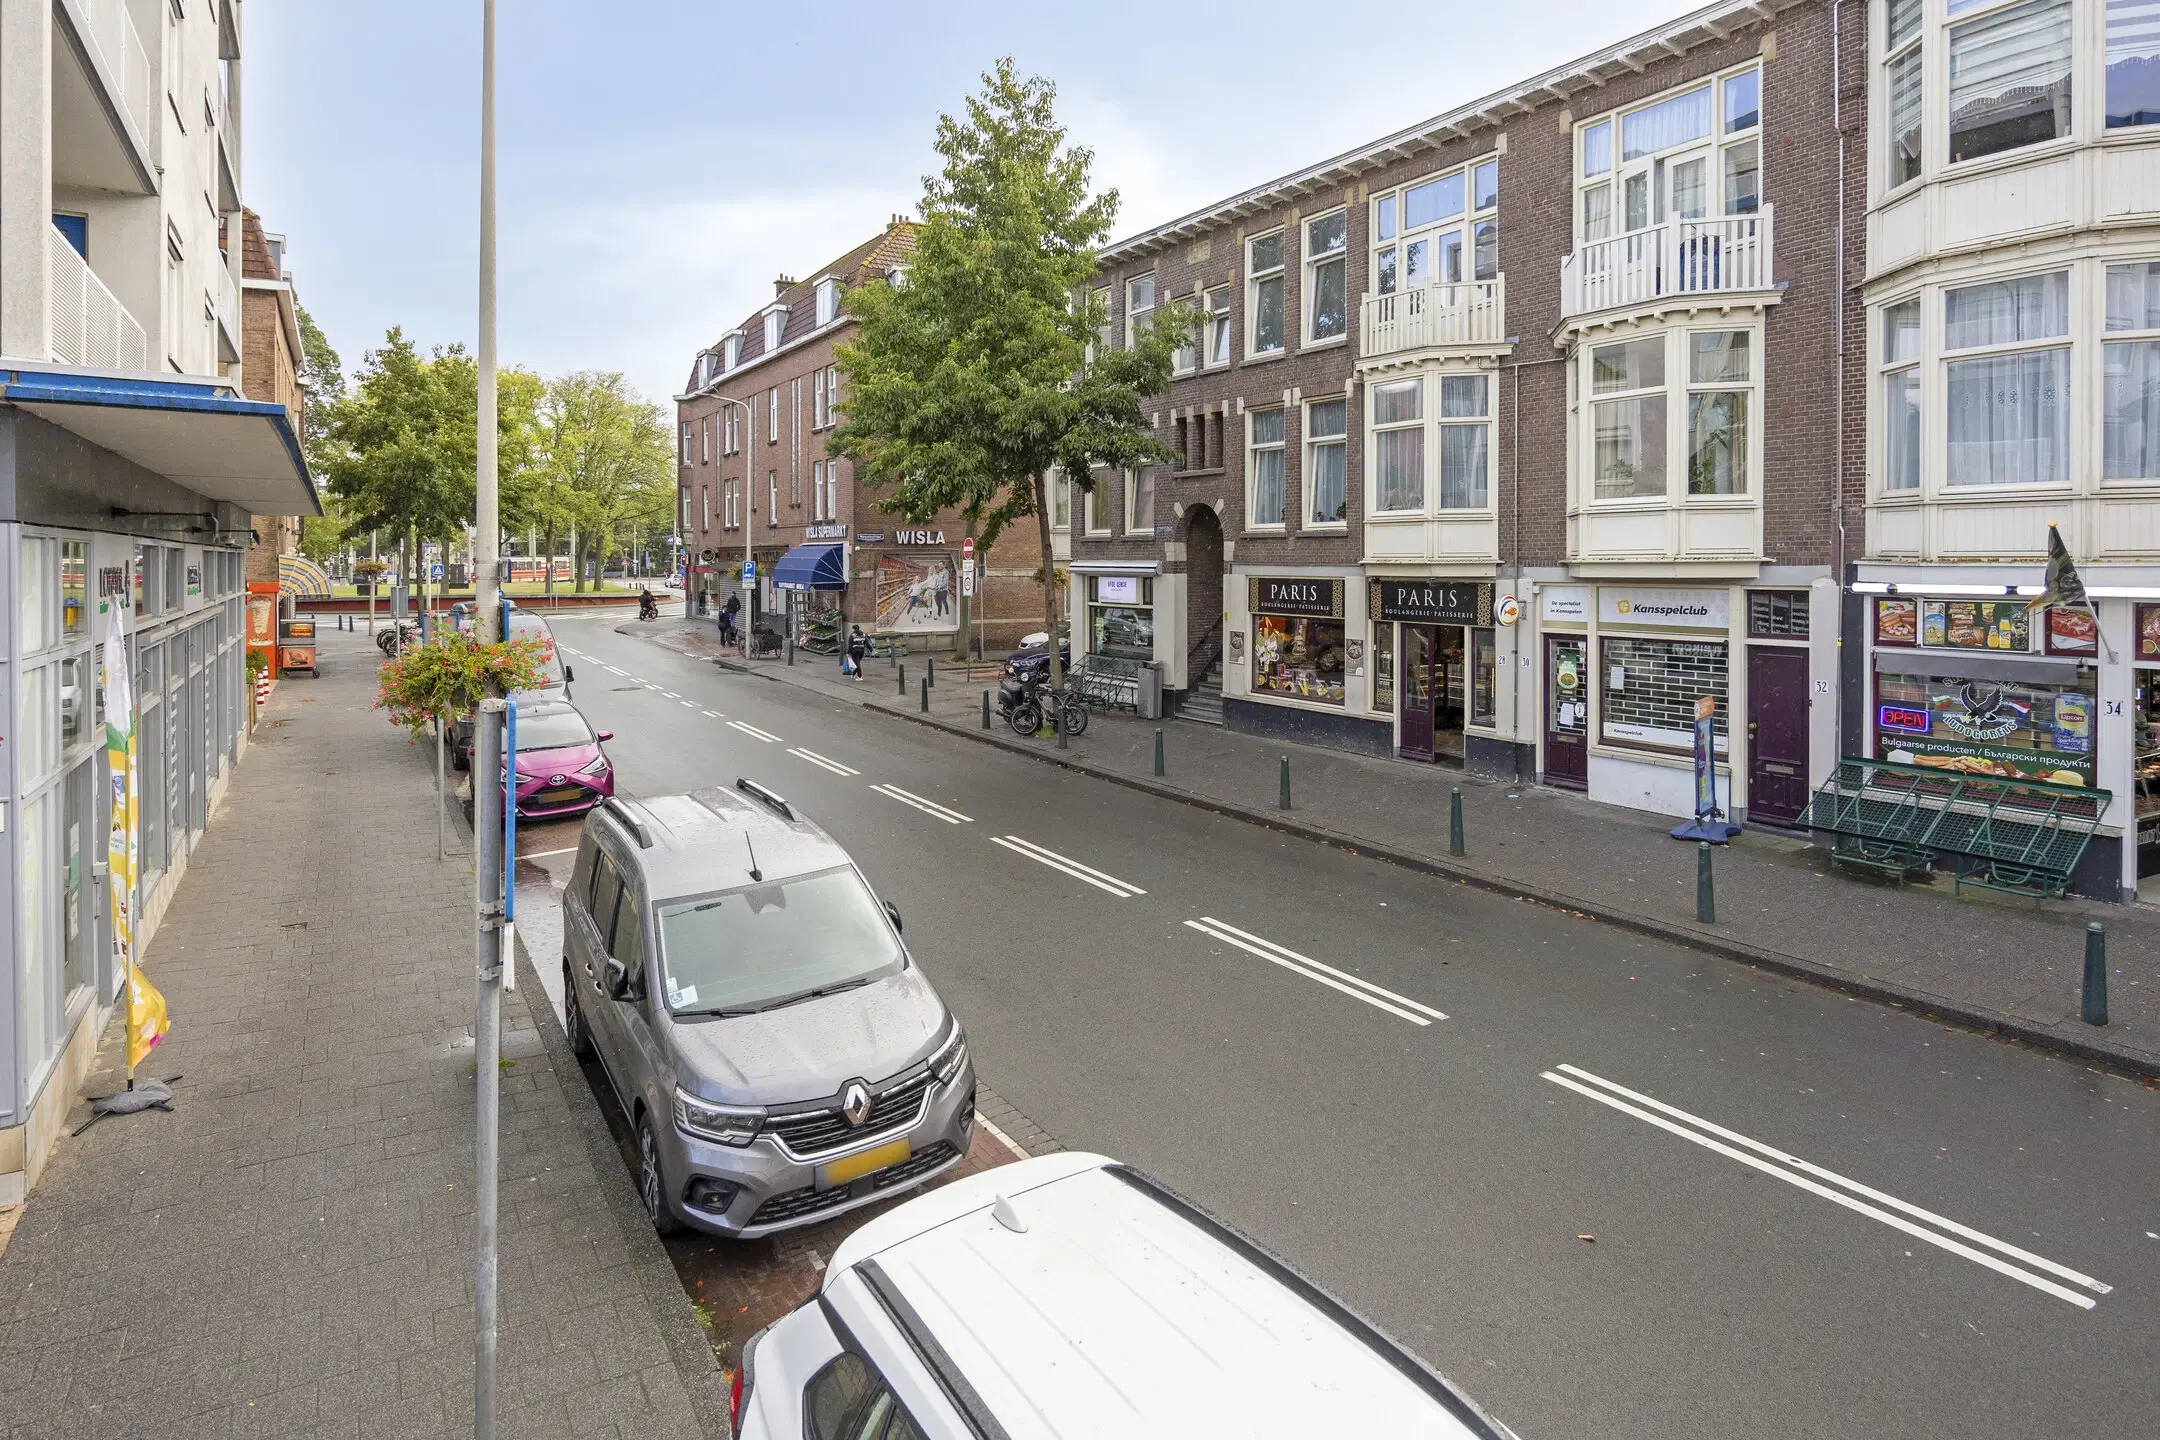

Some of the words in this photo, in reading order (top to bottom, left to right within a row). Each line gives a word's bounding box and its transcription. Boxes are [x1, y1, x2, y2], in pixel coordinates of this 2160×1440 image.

[896, 531, 946, 545] WISLA
[745, 562, 753, 573] P
[1270, 584, 1317, 601] PARIS
[1397, 588, 1457, 608] PARIS
[1633, 604, 1708, 616] Kansspelclub
[1816, 681, 1828, 693] 32
[2106, 701, 2121, 716] 34
[1884, 710, 1925, 727] OPEN
[2060, 713, 2083, 722] Lipton
[1943, 715, 2018, 739] LUDOGORETS
[1881, 736, 1925, 749] Bulgaarse
[1927, 743, 1976, 755] producten
[1984, 748, 2037, 761] Български
[2039, 756, 2091, 769] продукти
